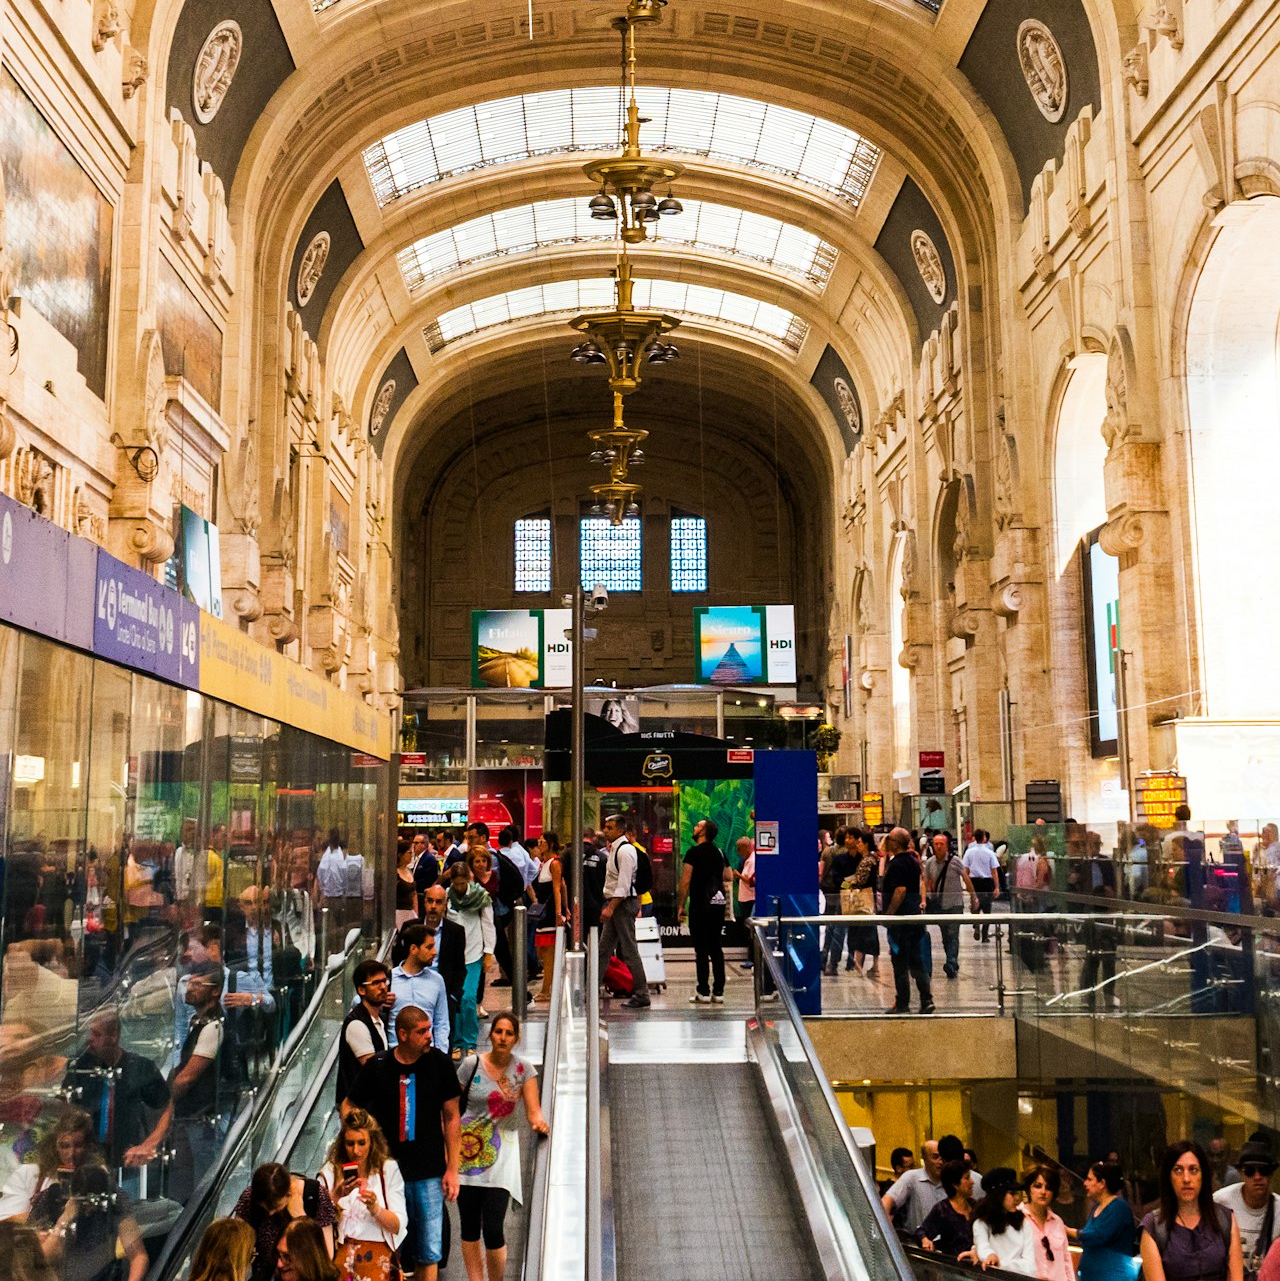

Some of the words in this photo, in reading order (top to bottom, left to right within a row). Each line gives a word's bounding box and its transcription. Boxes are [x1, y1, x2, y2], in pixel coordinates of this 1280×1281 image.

[547, 644, 569, 653] HDI
[770, 640, 792, 649] HDI
[407, 814, 448, 823] PIZZERIA
